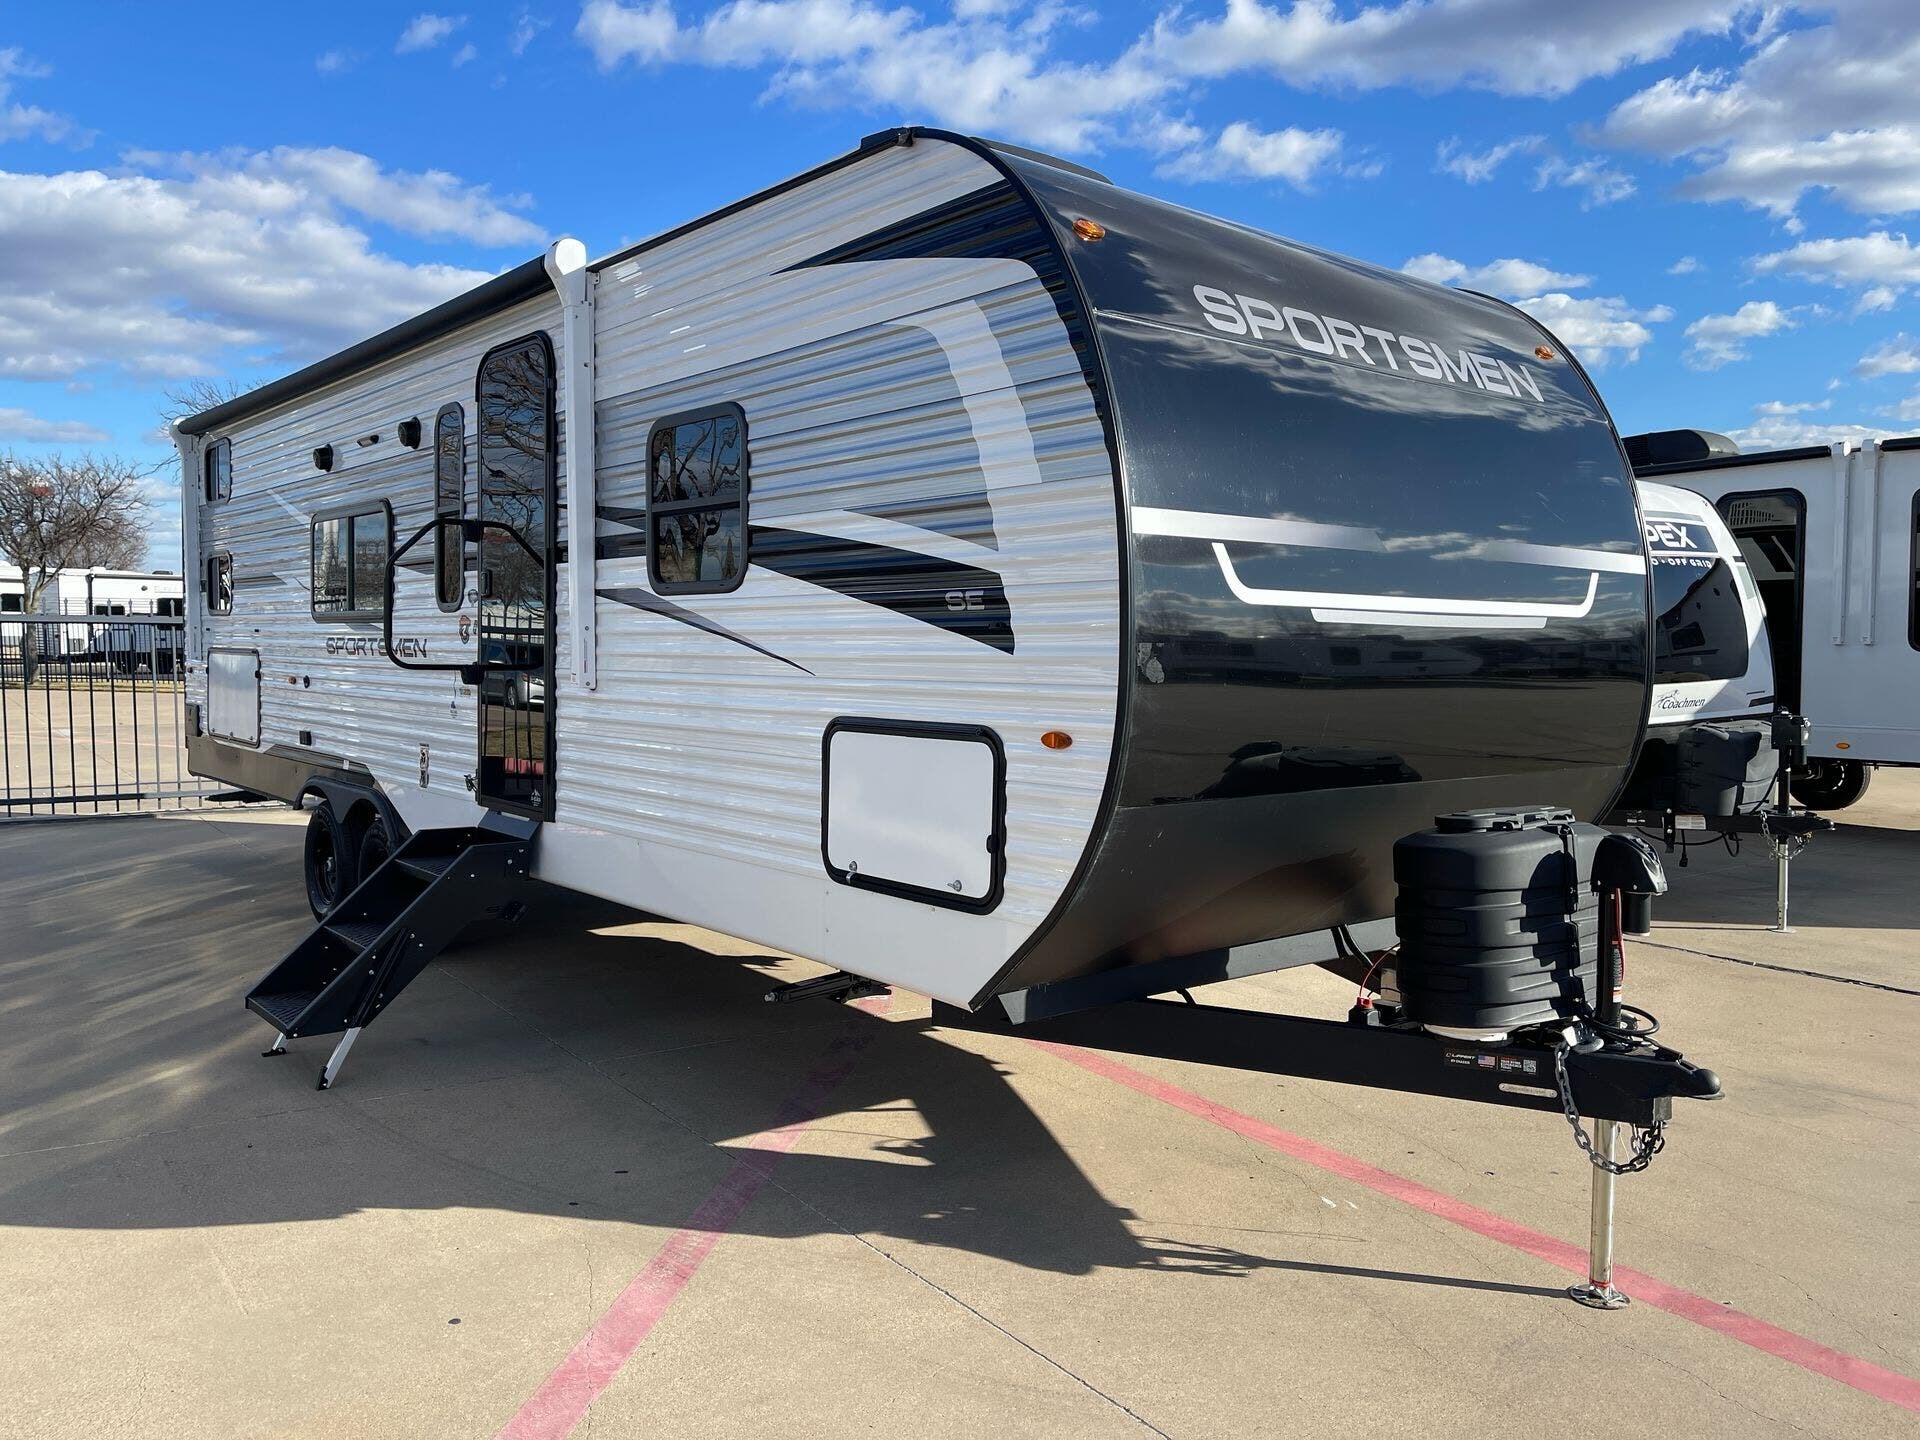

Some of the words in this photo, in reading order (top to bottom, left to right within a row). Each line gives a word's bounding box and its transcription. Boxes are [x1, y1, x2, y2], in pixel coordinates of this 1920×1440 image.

[1193, 284, 1545, 403] SPORTSMEN
[1667, 558, 1688, 566] OFF
[1689, 559, 1712, 569] GRID
[945, 590, 985, 611] SE
[326, 637, 428, 658] SPORTSMEN
[1661, 698, 1706, 710] Coachmen
